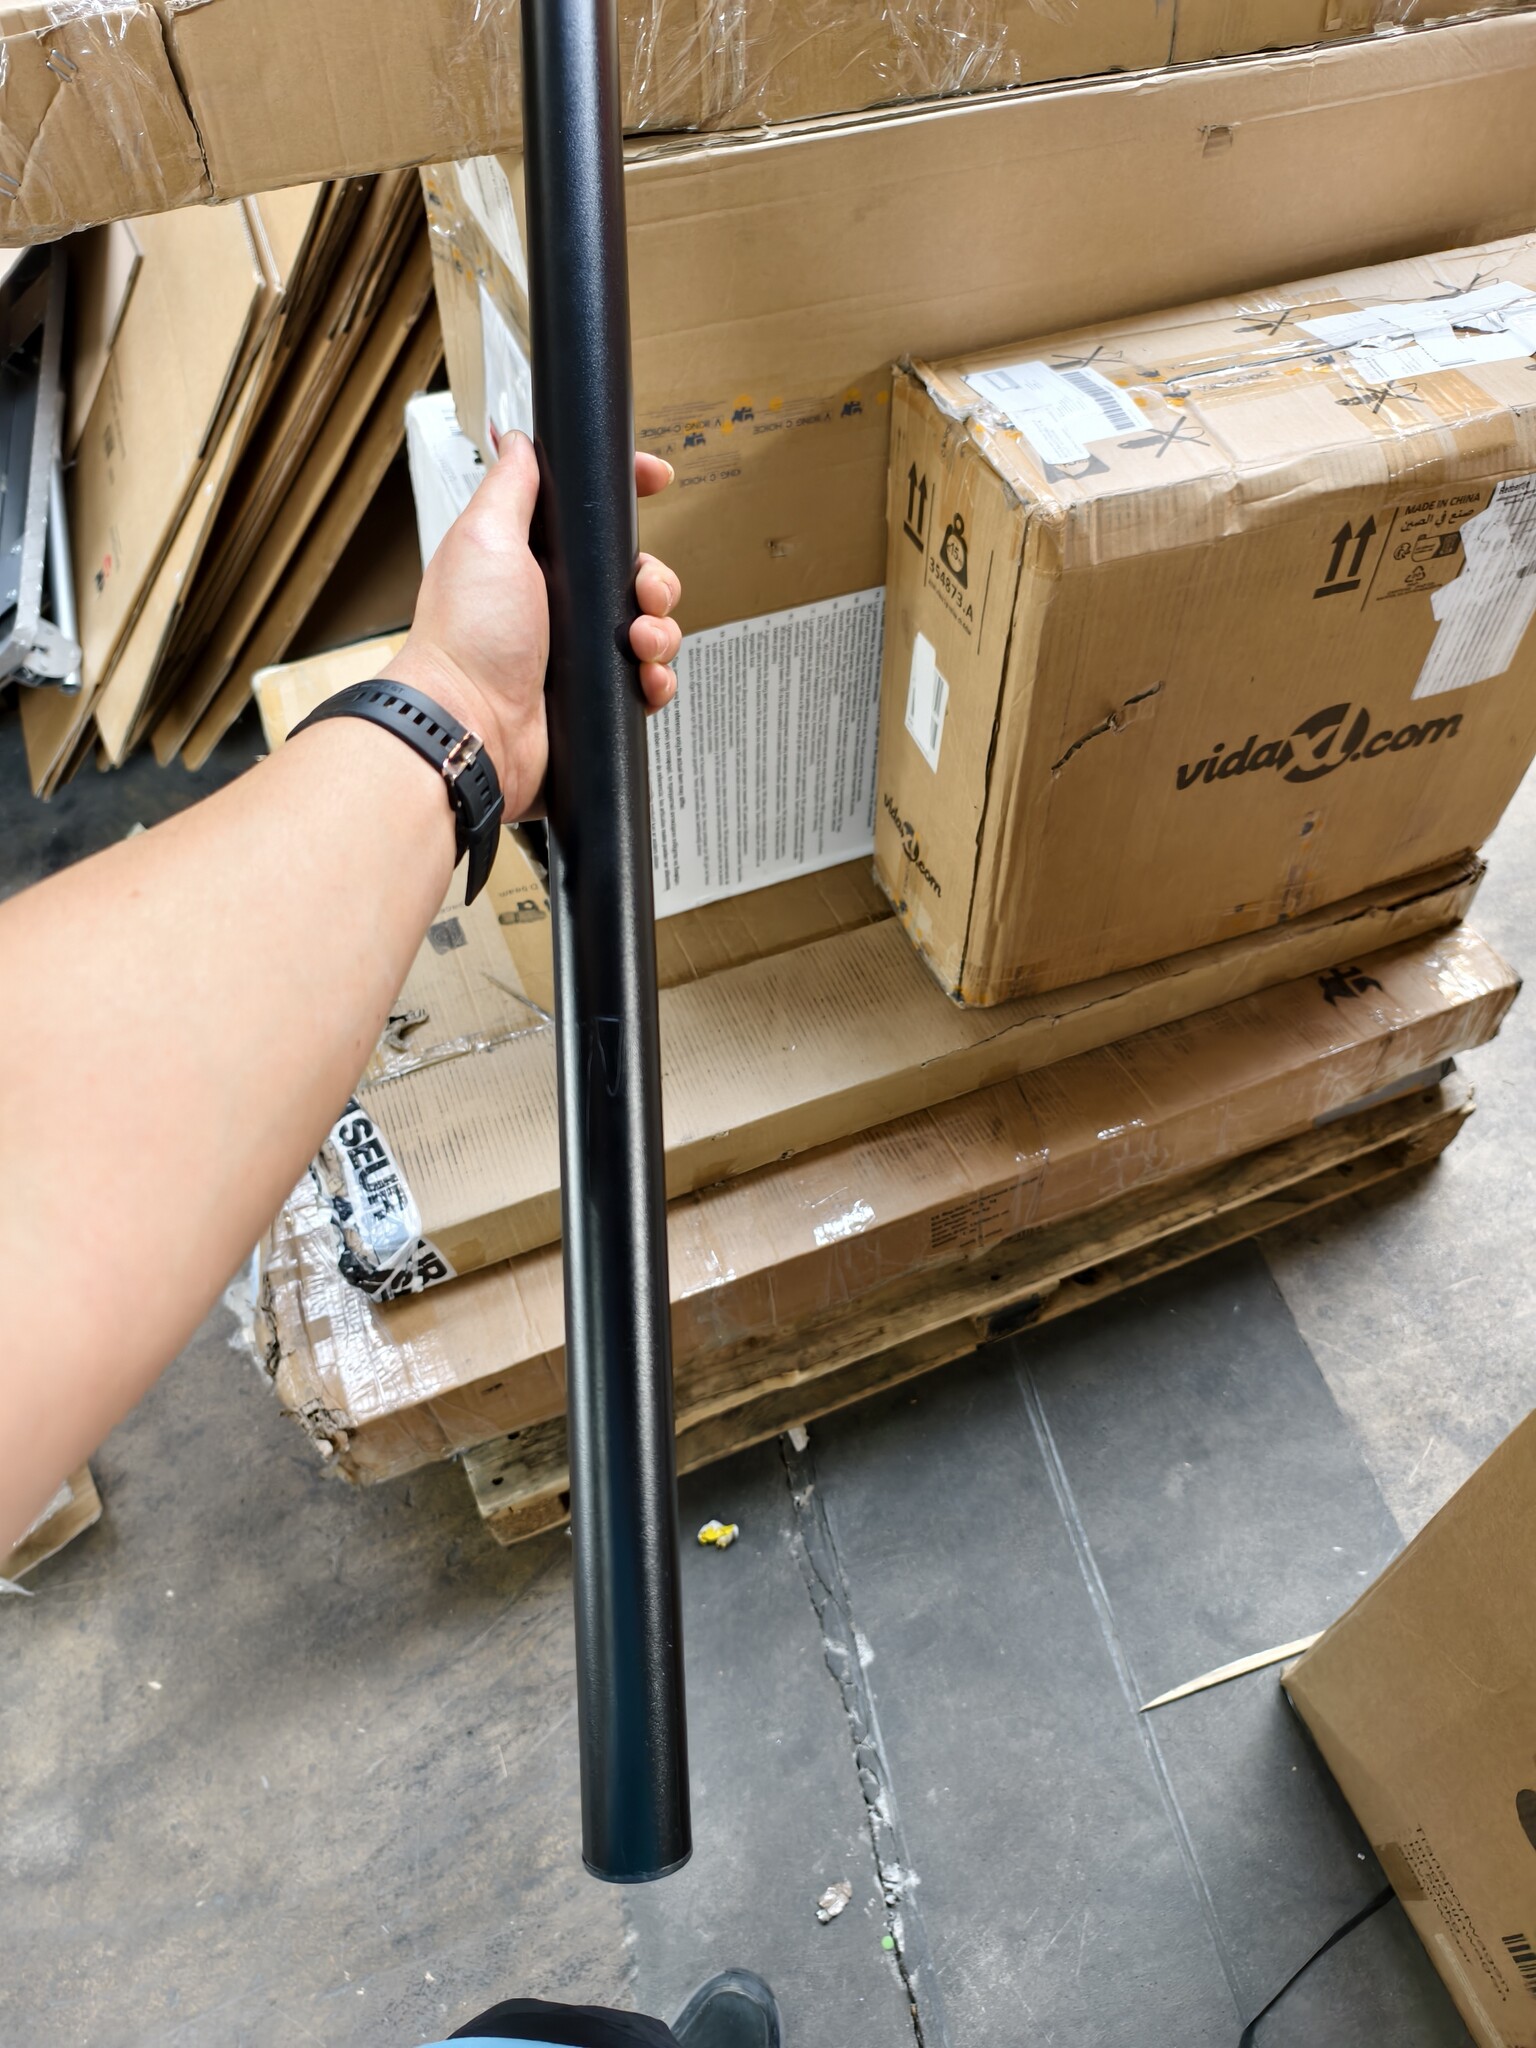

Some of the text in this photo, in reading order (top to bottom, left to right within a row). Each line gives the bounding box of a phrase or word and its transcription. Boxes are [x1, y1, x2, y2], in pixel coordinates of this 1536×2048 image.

[1400, 508, 1475, 533] صنع في الصين
[1404, 502, 1435, 516] MADE
[1435, 498, 1449, 510] IN
[1450, 492, 1481, 507] CHINA
[928, 557, 974, 622] 354873.A
[1176, 702, 1464, 790] vidaXL.com
